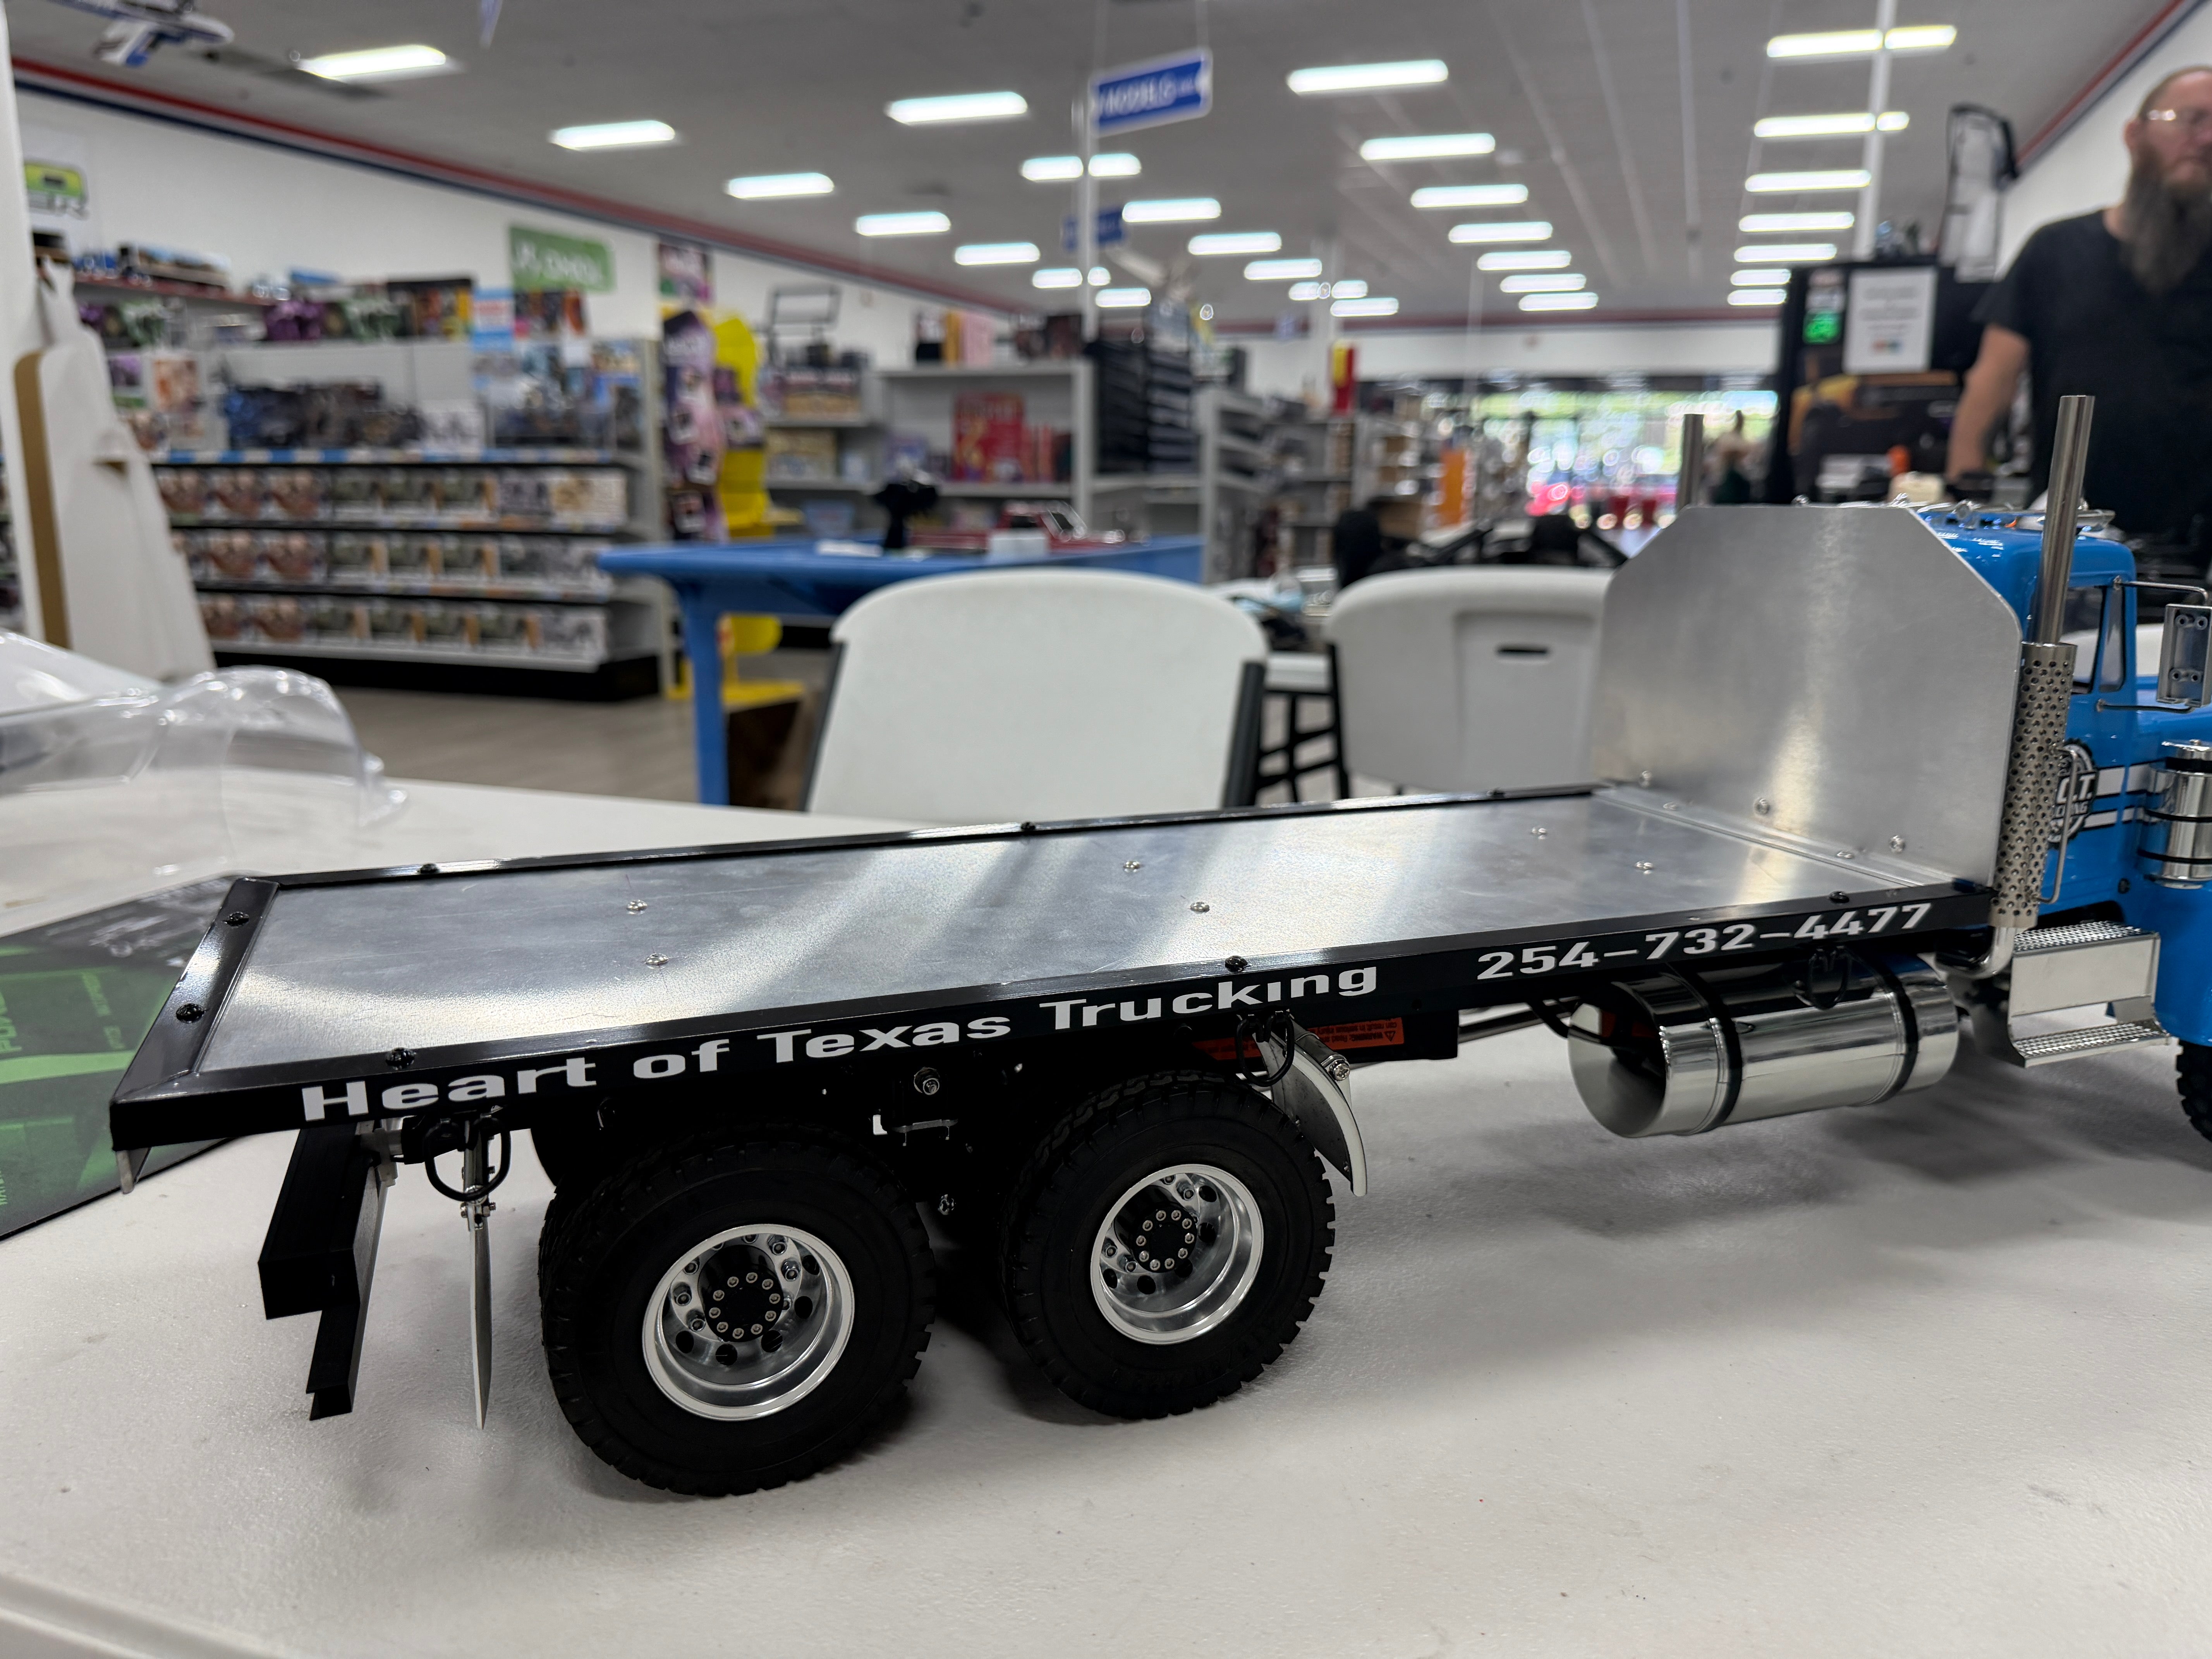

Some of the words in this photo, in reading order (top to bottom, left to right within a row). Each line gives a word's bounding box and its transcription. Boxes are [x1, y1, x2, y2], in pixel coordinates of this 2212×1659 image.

[1477, 903, 1931, 979] 254-732-4477
[302, 1058, 596, 1120] Heart
[634, 1039, 729, 1078] of
[757, 1017, 1010, 1063] Texas
[1039, 967, 1376, 1030] Trucking
